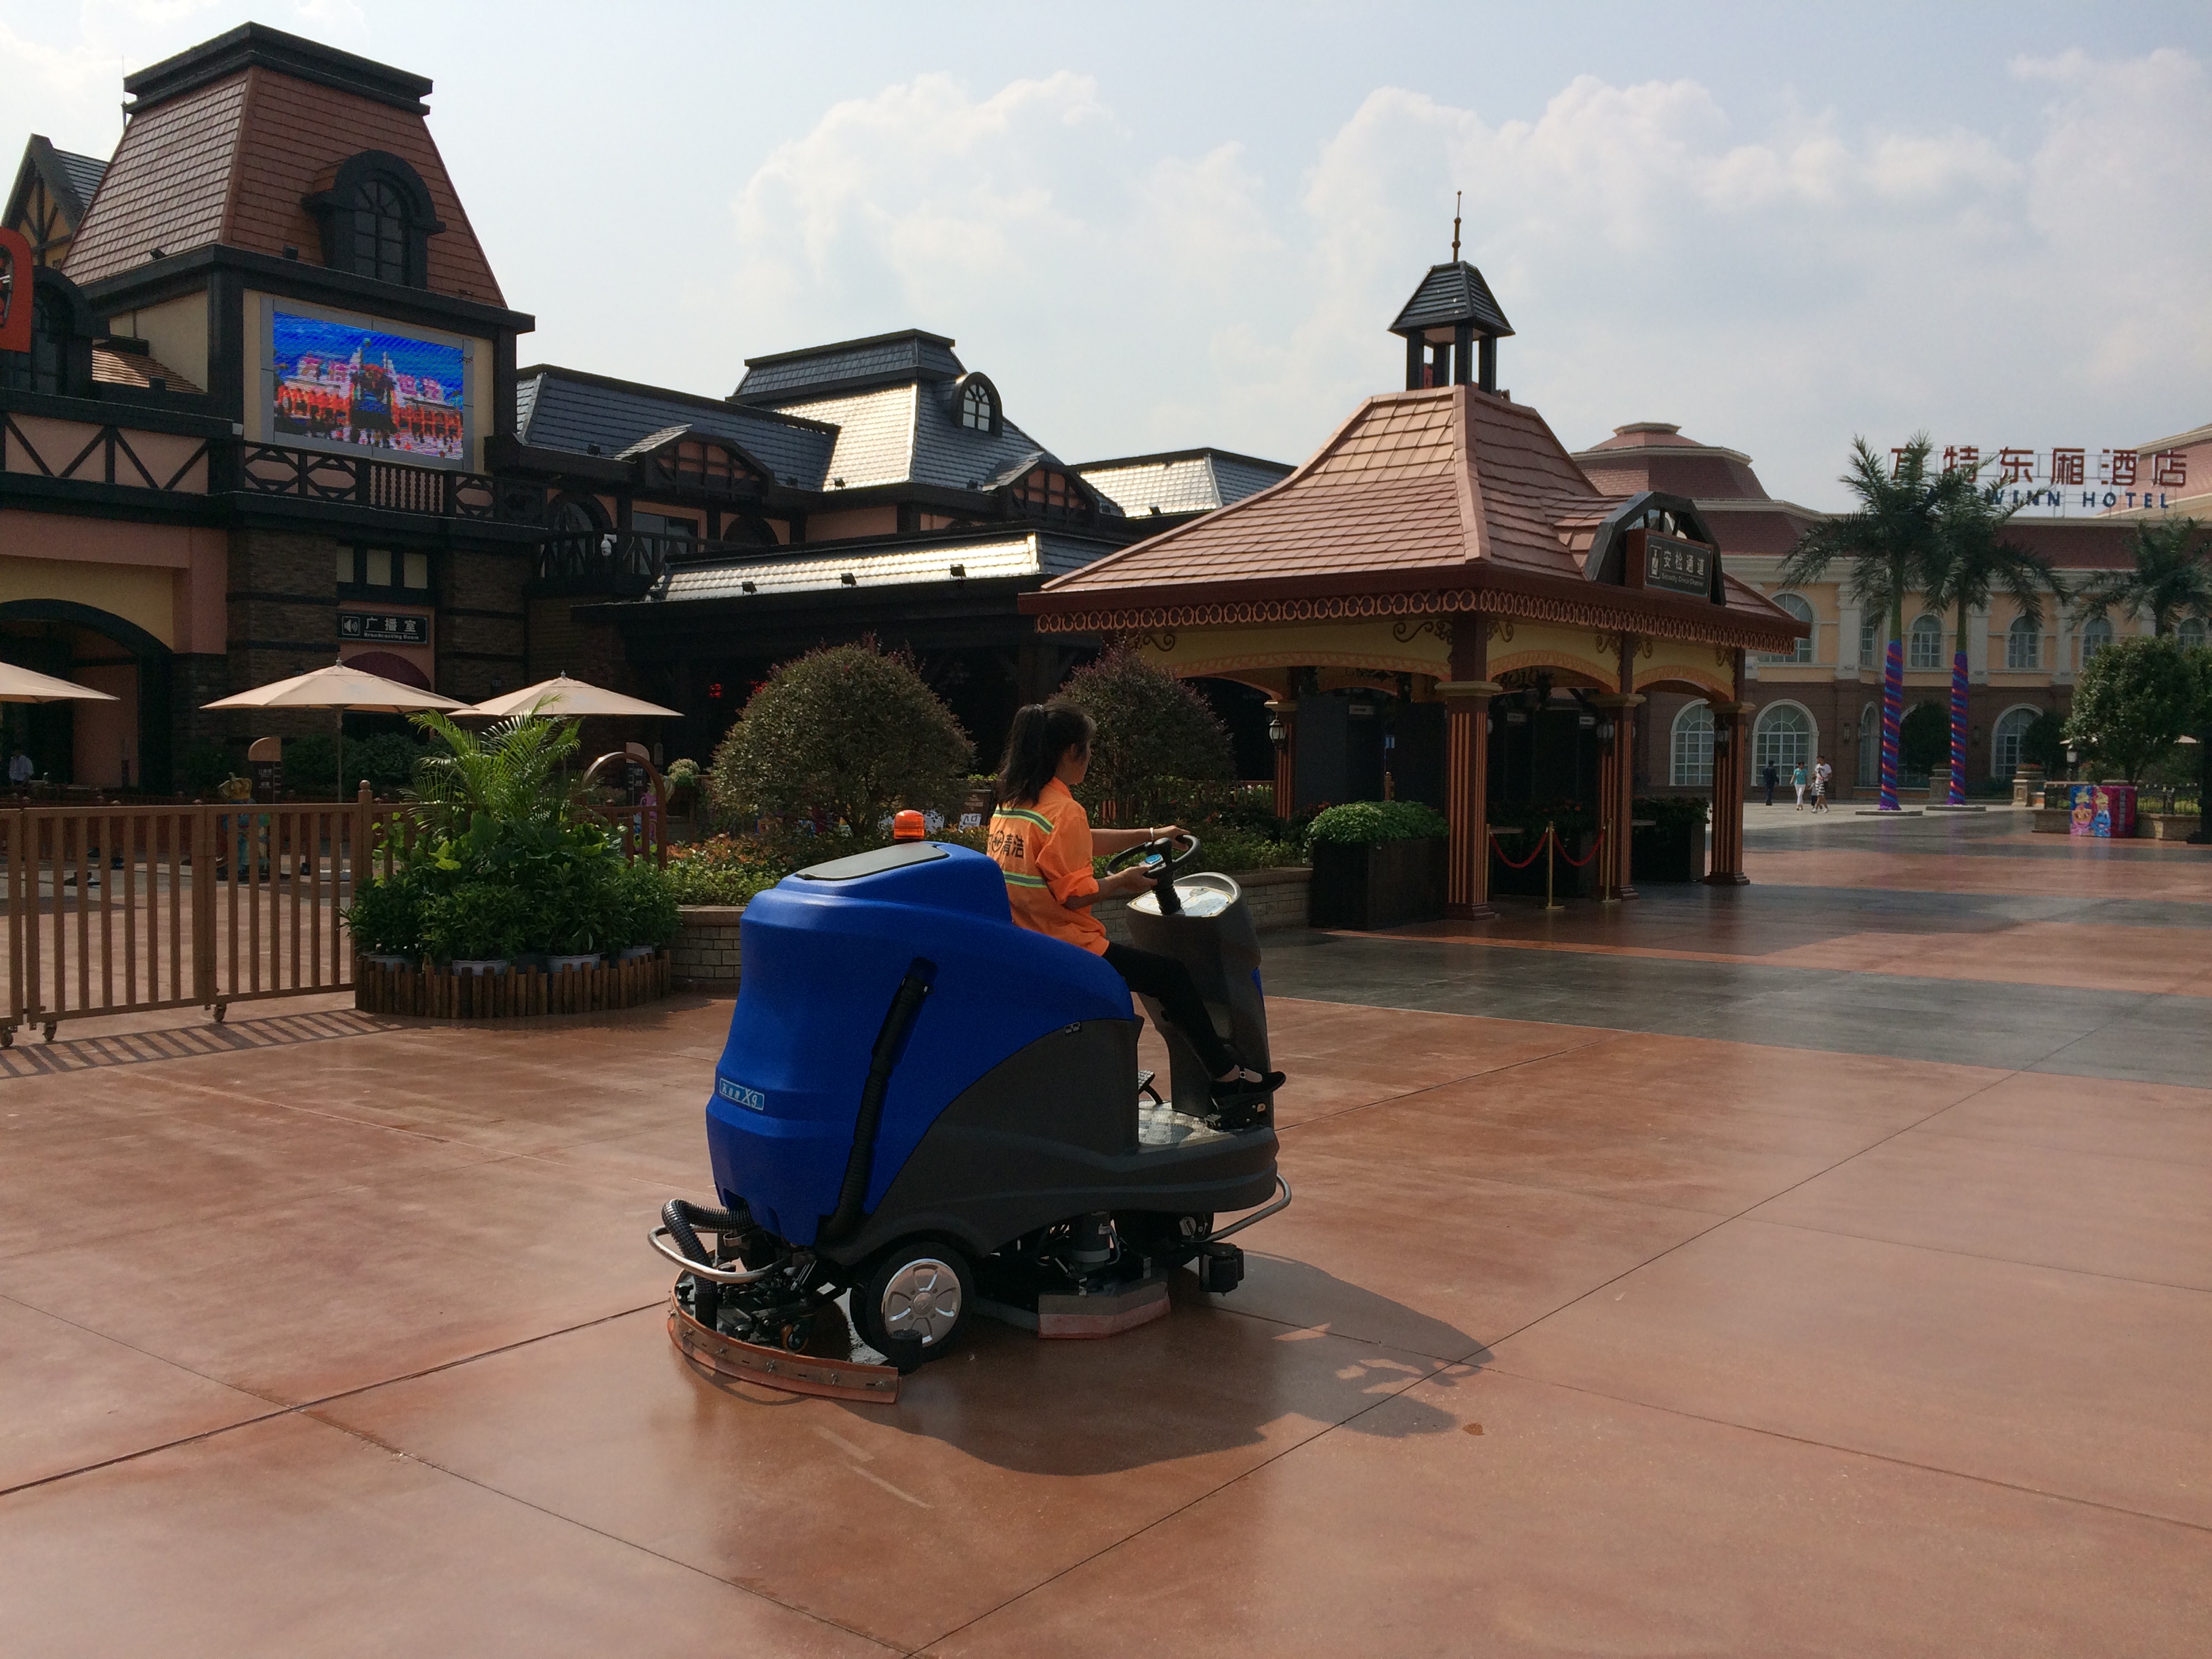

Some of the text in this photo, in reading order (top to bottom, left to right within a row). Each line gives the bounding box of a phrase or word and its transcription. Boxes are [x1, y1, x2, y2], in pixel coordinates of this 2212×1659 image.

[2083, 491, 2169, 508] HOTEL
[365, 616, 417, 633] 广播室
[363, 632, 403, 640] Broadcasting
[1002, 833, 1024, 859] 清洁
